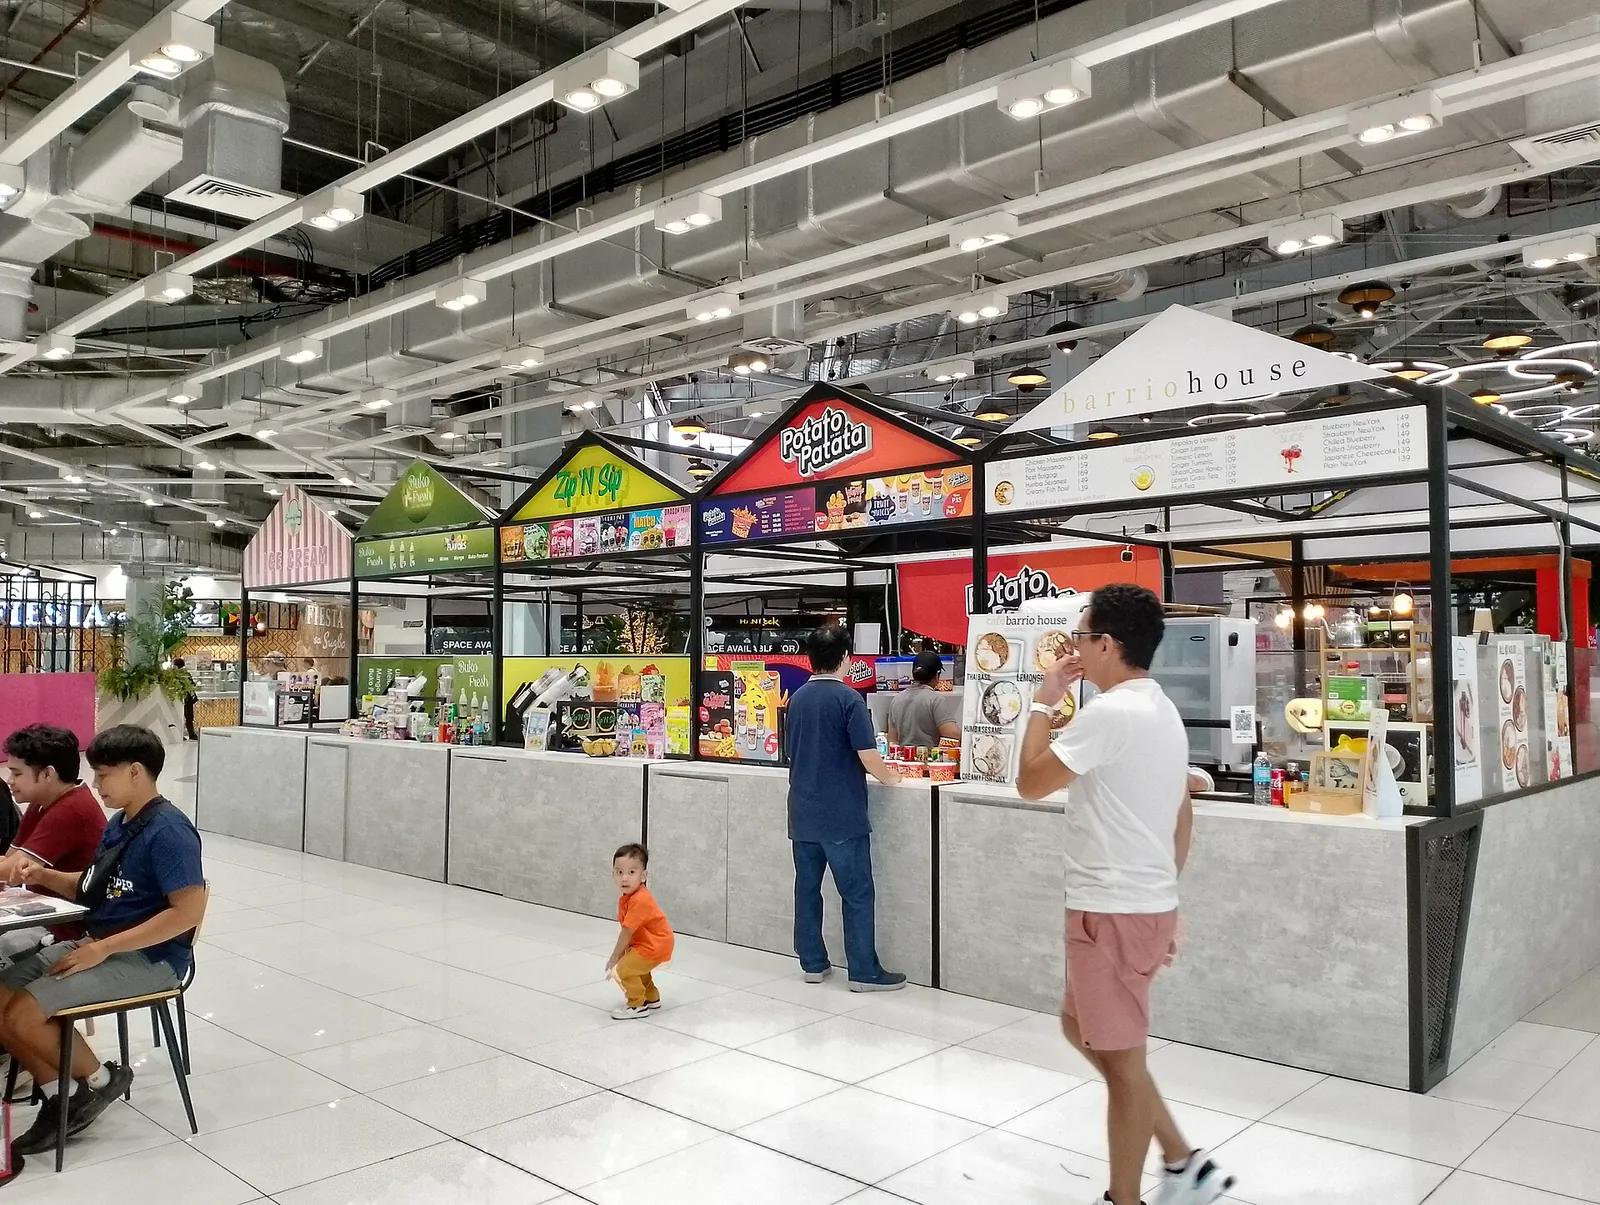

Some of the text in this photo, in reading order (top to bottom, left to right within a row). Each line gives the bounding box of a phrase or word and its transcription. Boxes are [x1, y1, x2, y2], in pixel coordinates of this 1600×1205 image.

[1322, 423, 1351, 432] Blueberry
[1397, 413, 1409, 422] 149
[782, 410, 845, 458] Potato
[1323, 430, 1356, 440] Strawberry
[1397, 422, 1410, 430] 149
[1200, 436, 1218, 444] Lemon
[1225, 434, 1235, 442] 109
[1323, 430, 1410, 447] Chilled Blueberry 149
[800, 423, 867, 472] Patata
[1170, 447, 1189, 456] Ginger
[1225, 441, 1235, 449] 109
[1225, 449, 1236, 457] 109
[1323, 438, 1410, 455] Chilled Strawberry 149
[1025, 459, 1046, 467] Chicken
[1078, 453, 1089, 462] 149
[1323, 446, 1411, 463] Japanese Cheesecake 139
[1323, 461, 1339, 469] Plain
[1398, 454, 1411, 462] 139
[1025, 466, 1036, 474] Pork
[1078, 461, 1089, 469] 159
[1170, 462, 1190, 470] Ginger
[1225, 456, 1236, 464] 109
[1205, 465, 1223, 473] Honey
[1078, 469, 1089, 477] 169
[1171, 471, 1236, 484] Lemon Grass Tea 109
[408, 473, 430, 490] Buko
[554, 471, 577, 507] Zip
[598, 462, 623, 502] Sip
[1226, 478, 1236, 486] 109
[412, 487, 432, 502] Fresh
[1025, 488, 1045, 496] Creamy
[1078, 484, 1089, 492] 139
[873, 499, 890, 509] FRUIT
[287, 544, 328, 571] CREAM
[366, 556, 384, 567] Fresh
[306, 604, 344, 629] FIESTA
[1005, 615, 1035, 626] barrio
[1037, 614, 1067, 625] house
[313, 630, 346, 657] sa Sugbo
[442, 640, 473, 650] SPACE
[458, 660, 479, 674] Buko
[469, 673, 490, 688] Fresh
[967, 673, 978, 681] THAI
